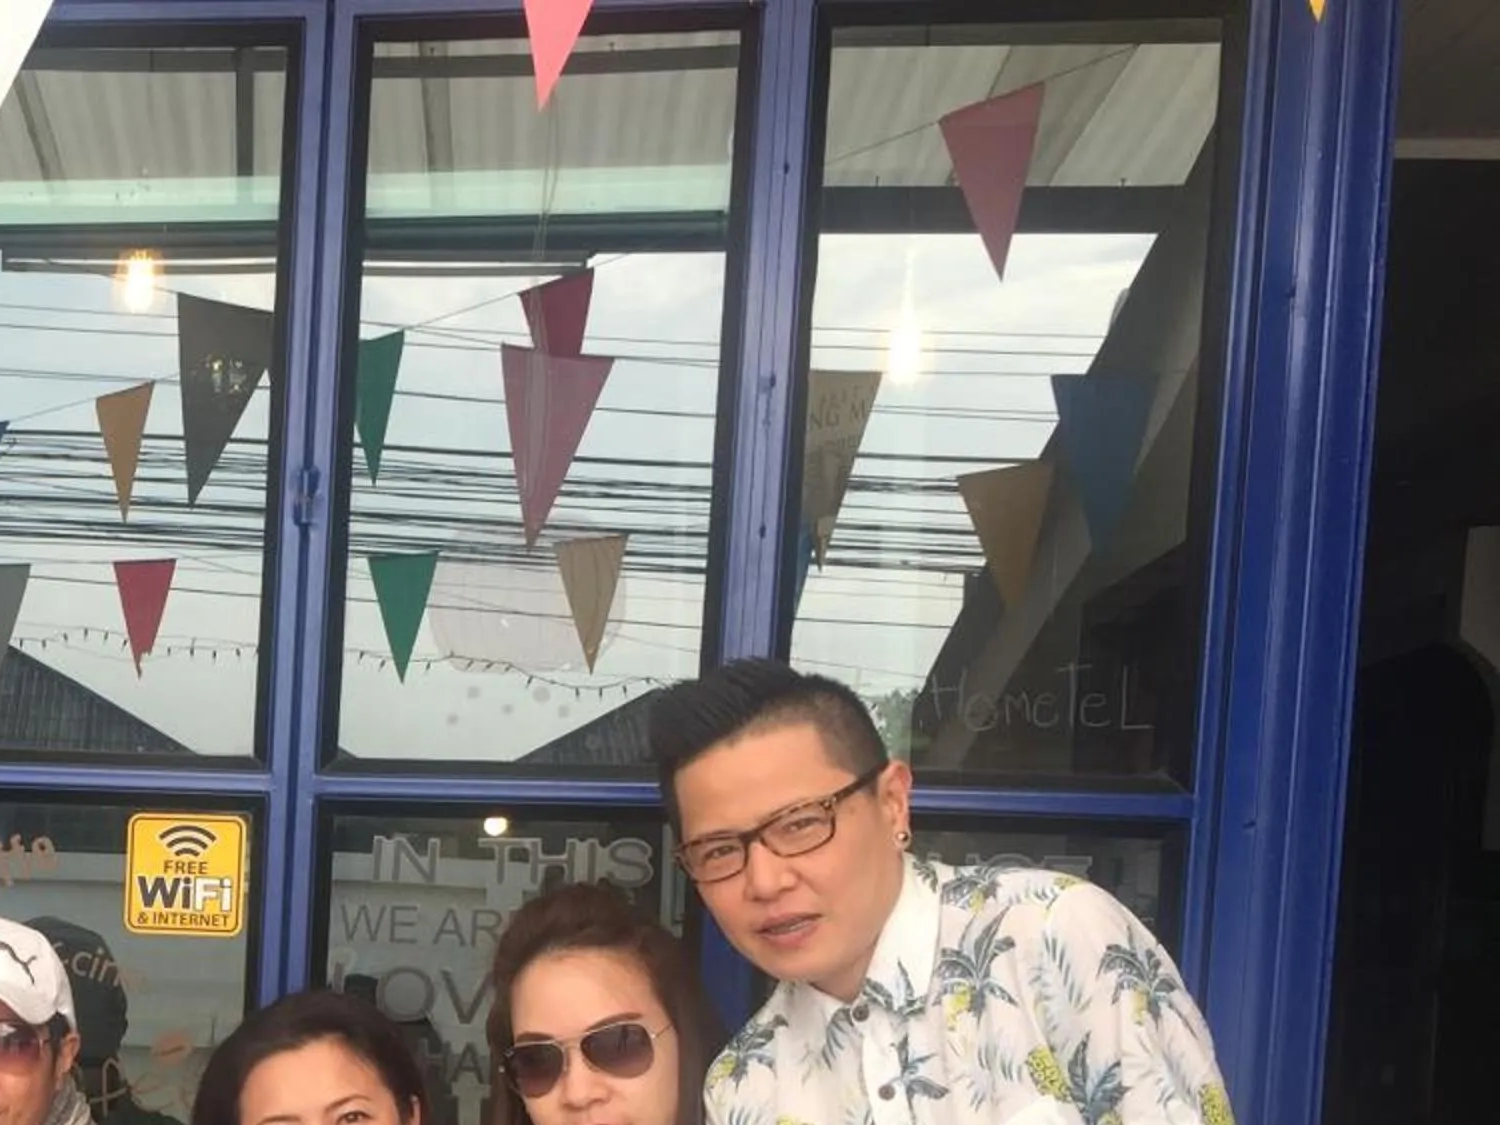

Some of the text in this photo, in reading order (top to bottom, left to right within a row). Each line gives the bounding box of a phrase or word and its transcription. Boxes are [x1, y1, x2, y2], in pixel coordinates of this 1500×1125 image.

[163, 860, 209, 875] FREE
[372, 835, 655, 888] IN THIS
[137, 876, 233, 912] WiFi
[137, 912, 230, 928] & INTERNET
[340, 903, 508, 948] WE AR
